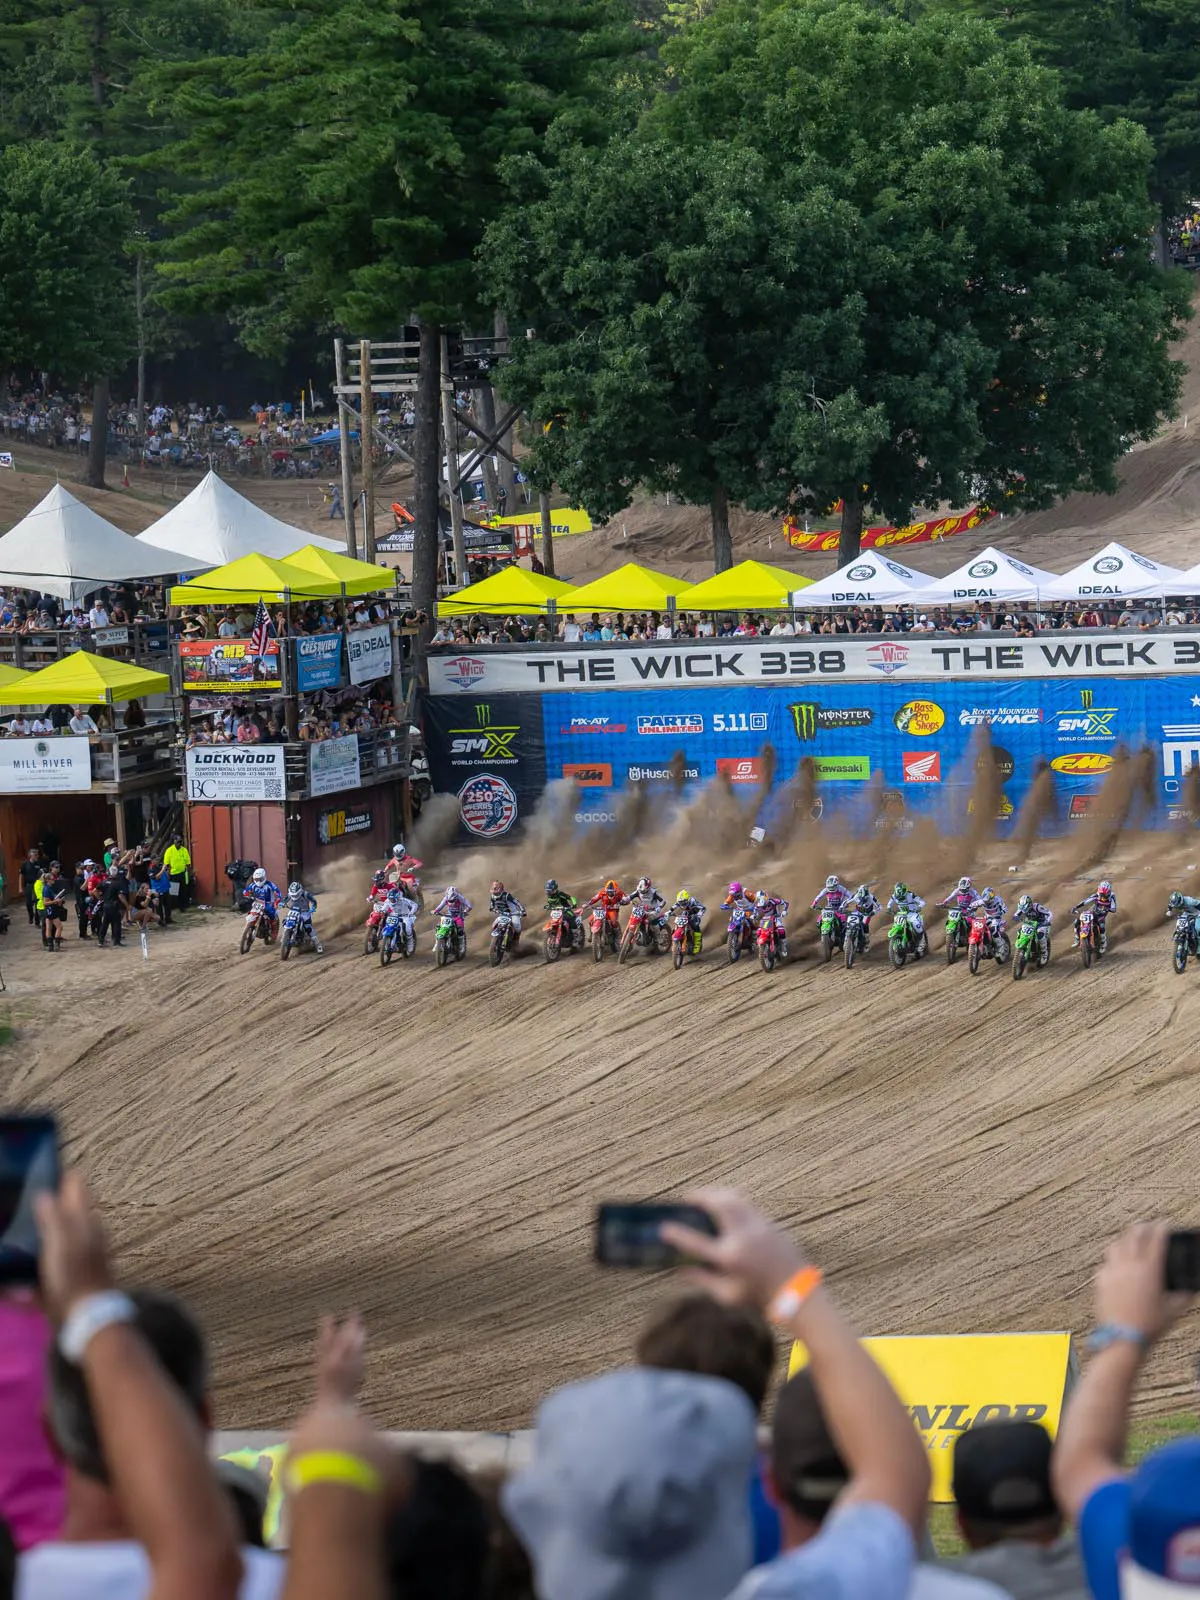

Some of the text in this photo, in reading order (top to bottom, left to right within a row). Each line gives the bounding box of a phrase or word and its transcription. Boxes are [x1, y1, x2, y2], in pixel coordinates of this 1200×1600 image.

[953, 588, 997, 598] IDEAL
[1078, 585, 1122, 595] IDEAL
[831, 592, 875, 601] IDEAL
[223, 644, 246, 659] MB
[931, 646, 1024, 671] THE
[1040, 642, 1158, 668] WICK
[526, 650, 846, 683] THE WICK 338
[914, 702, 933, 712] Bass
[818, 709, 871, 719] MONSTER
[916, 712, 929, 721] Pro
[638, 715, 703, 727] PARTS
[713, 714, 749, 732] 5.11
[916, 720, 940, 732] Shops
[1057, 713, 1115, 735] SMX
[639, 726, 703, 734] UNLIMITED
[450, 732, 517, 757] SMX
[13, 758, 73, 769] MILL RIVER
[195, 754, 276, 764] LOCKWOOD
[815, 763, 863, 772] Kawasaki
[574, 769, 603, 781] KTM
[467, 792, 493, 802] 250
[574, 811, 619, 823] eacoc
[327, 810, 346, 838] MB
